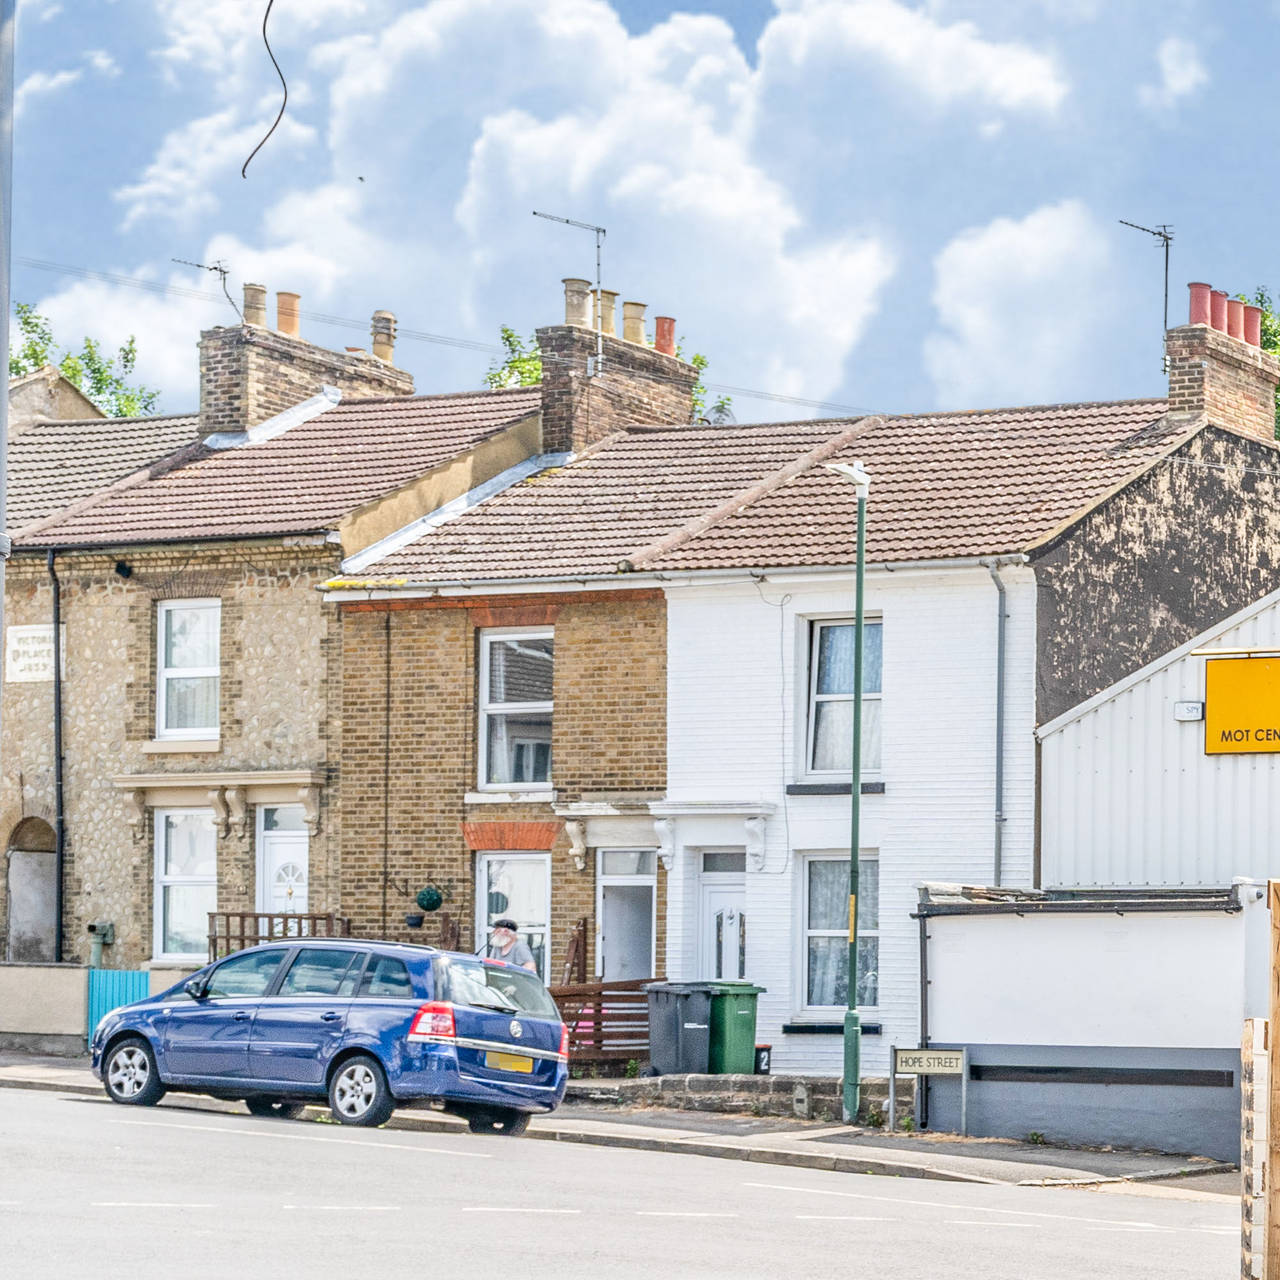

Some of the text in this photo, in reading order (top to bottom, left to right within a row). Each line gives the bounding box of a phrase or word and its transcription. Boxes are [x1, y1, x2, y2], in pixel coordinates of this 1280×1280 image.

[1220, 729, 1251, 743] MOT
[760, 1051, 769, 1070] 2
[900, 1056, 961, 1068] HOPE STREET
